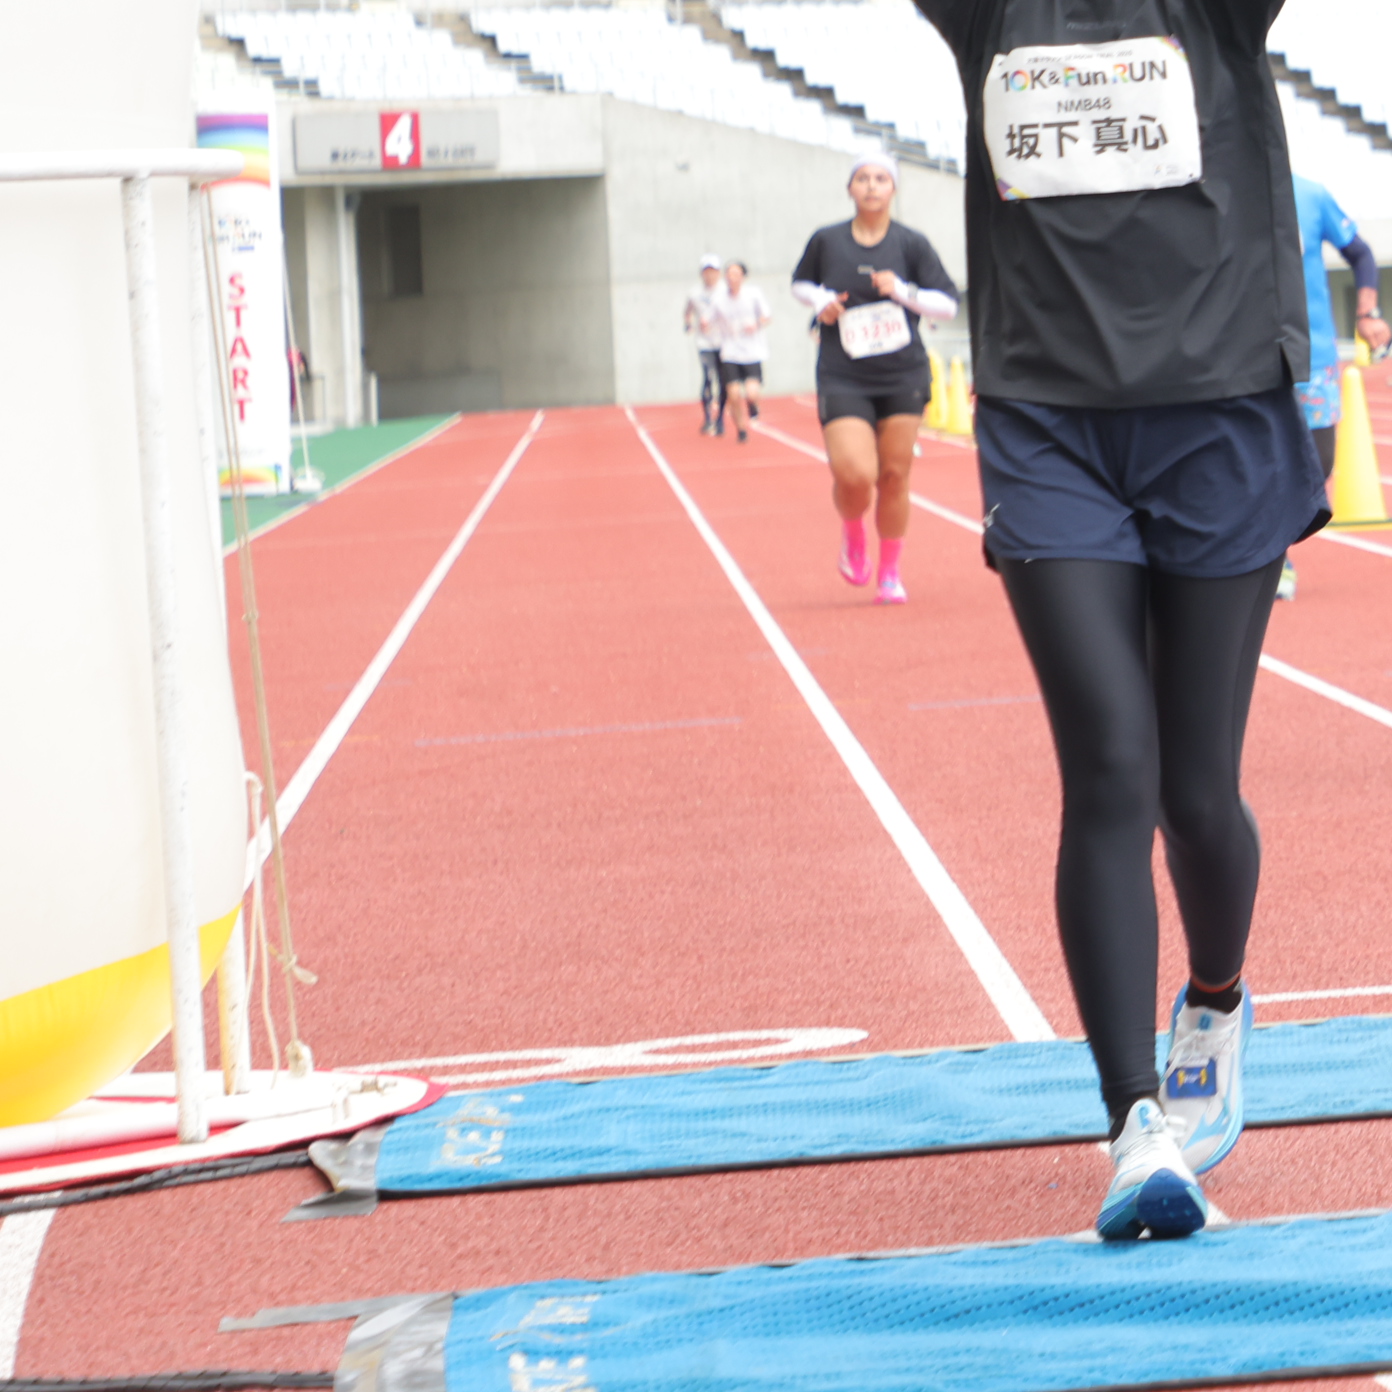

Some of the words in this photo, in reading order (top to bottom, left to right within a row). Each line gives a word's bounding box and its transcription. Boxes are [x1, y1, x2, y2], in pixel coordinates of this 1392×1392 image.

[1112, 60, 1168, 84] RUN
[1057, 96, 1112, 113] NMB48
[384, 112, 415, 165] 4
[227, 272, 253, 423] START
